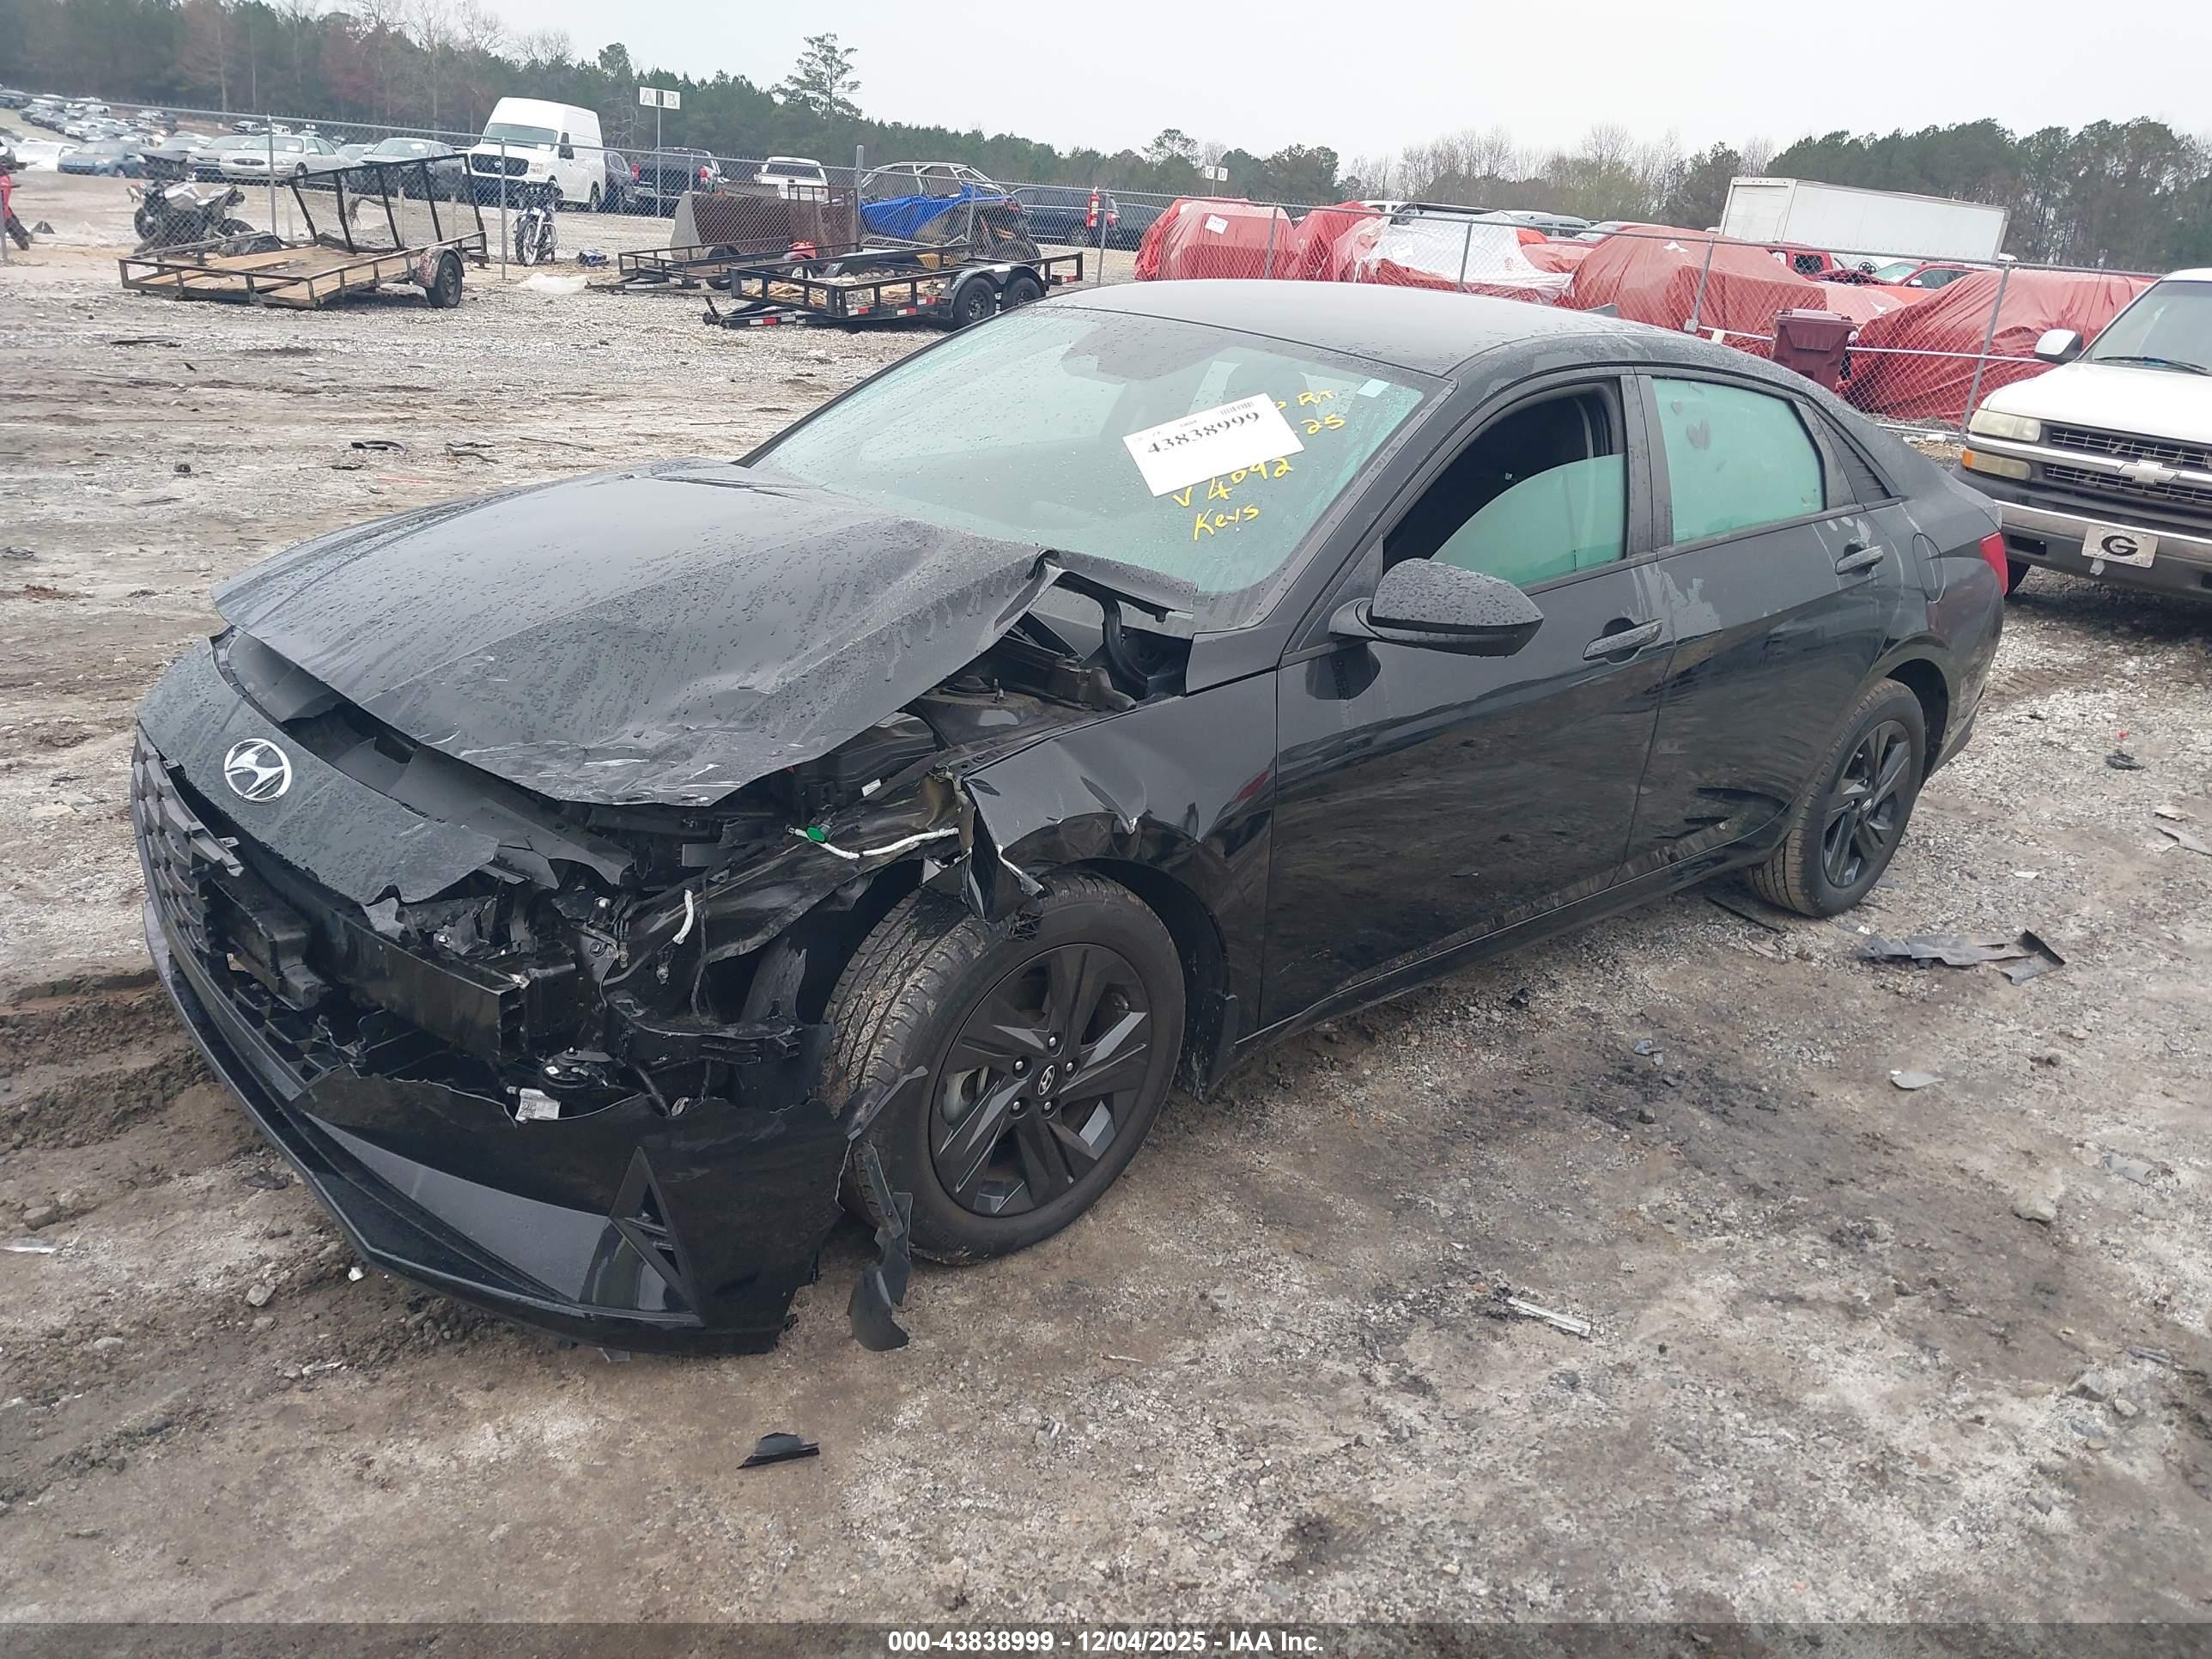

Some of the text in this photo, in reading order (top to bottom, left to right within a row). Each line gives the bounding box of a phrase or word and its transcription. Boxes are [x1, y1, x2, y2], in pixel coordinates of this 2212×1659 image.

[642, 90, 677, 106] A B
[1148, 411, 1260, 453] 43838999
[1300, 413, 1346, 435] 25
[1207, 457, 1294, 501] 4092
[1194, 503, 1260, 542] Keys
[2101, 535, 2138, 556] G
